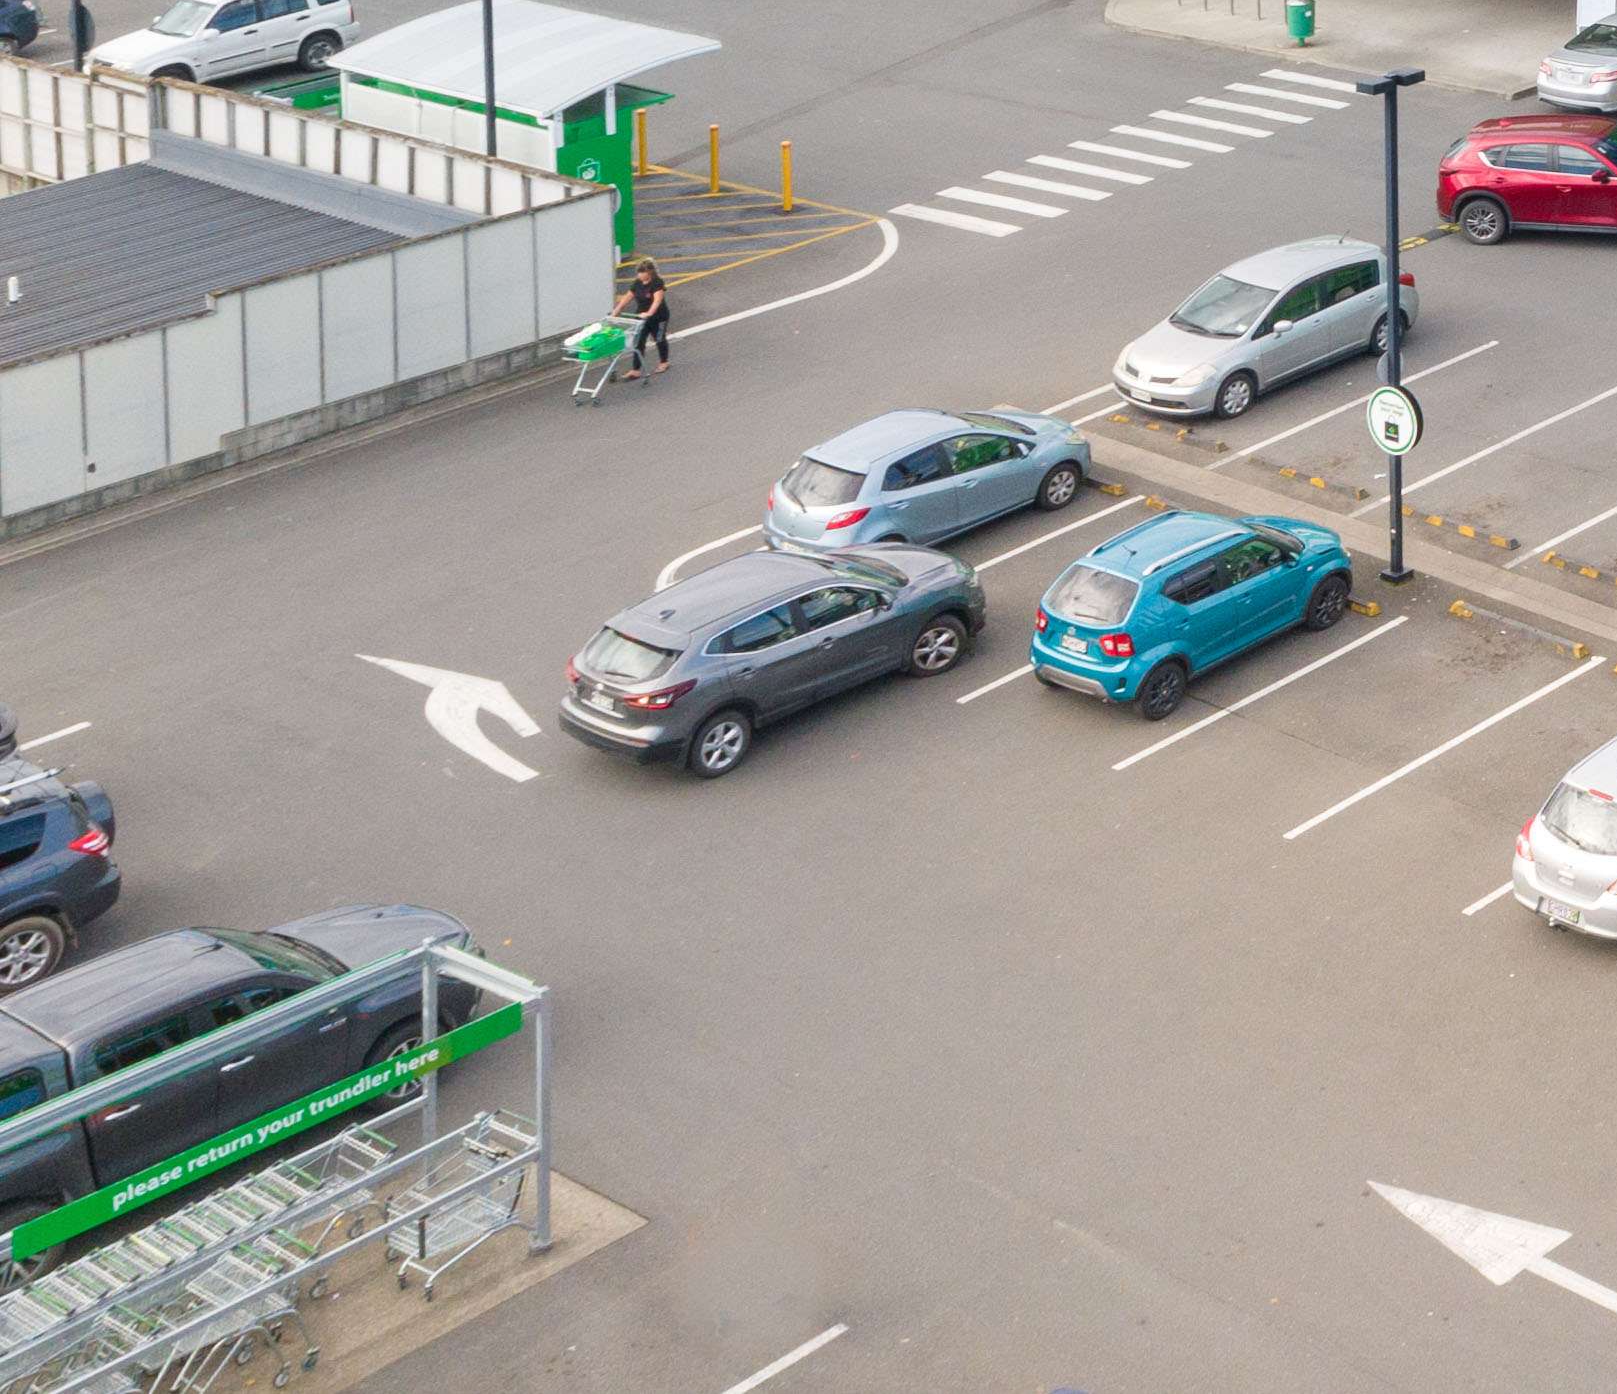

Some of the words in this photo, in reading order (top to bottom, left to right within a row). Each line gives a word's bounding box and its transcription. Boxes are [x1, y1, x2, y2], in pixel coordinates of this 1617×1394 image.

[112, 1164, 184, 1212] please
[186, 1132, 254, 1173] return
[256, 1108, 305, 1144] your
[309, 1069, 390, 1117] trundler
[394, 1048, 441, 1077] here
